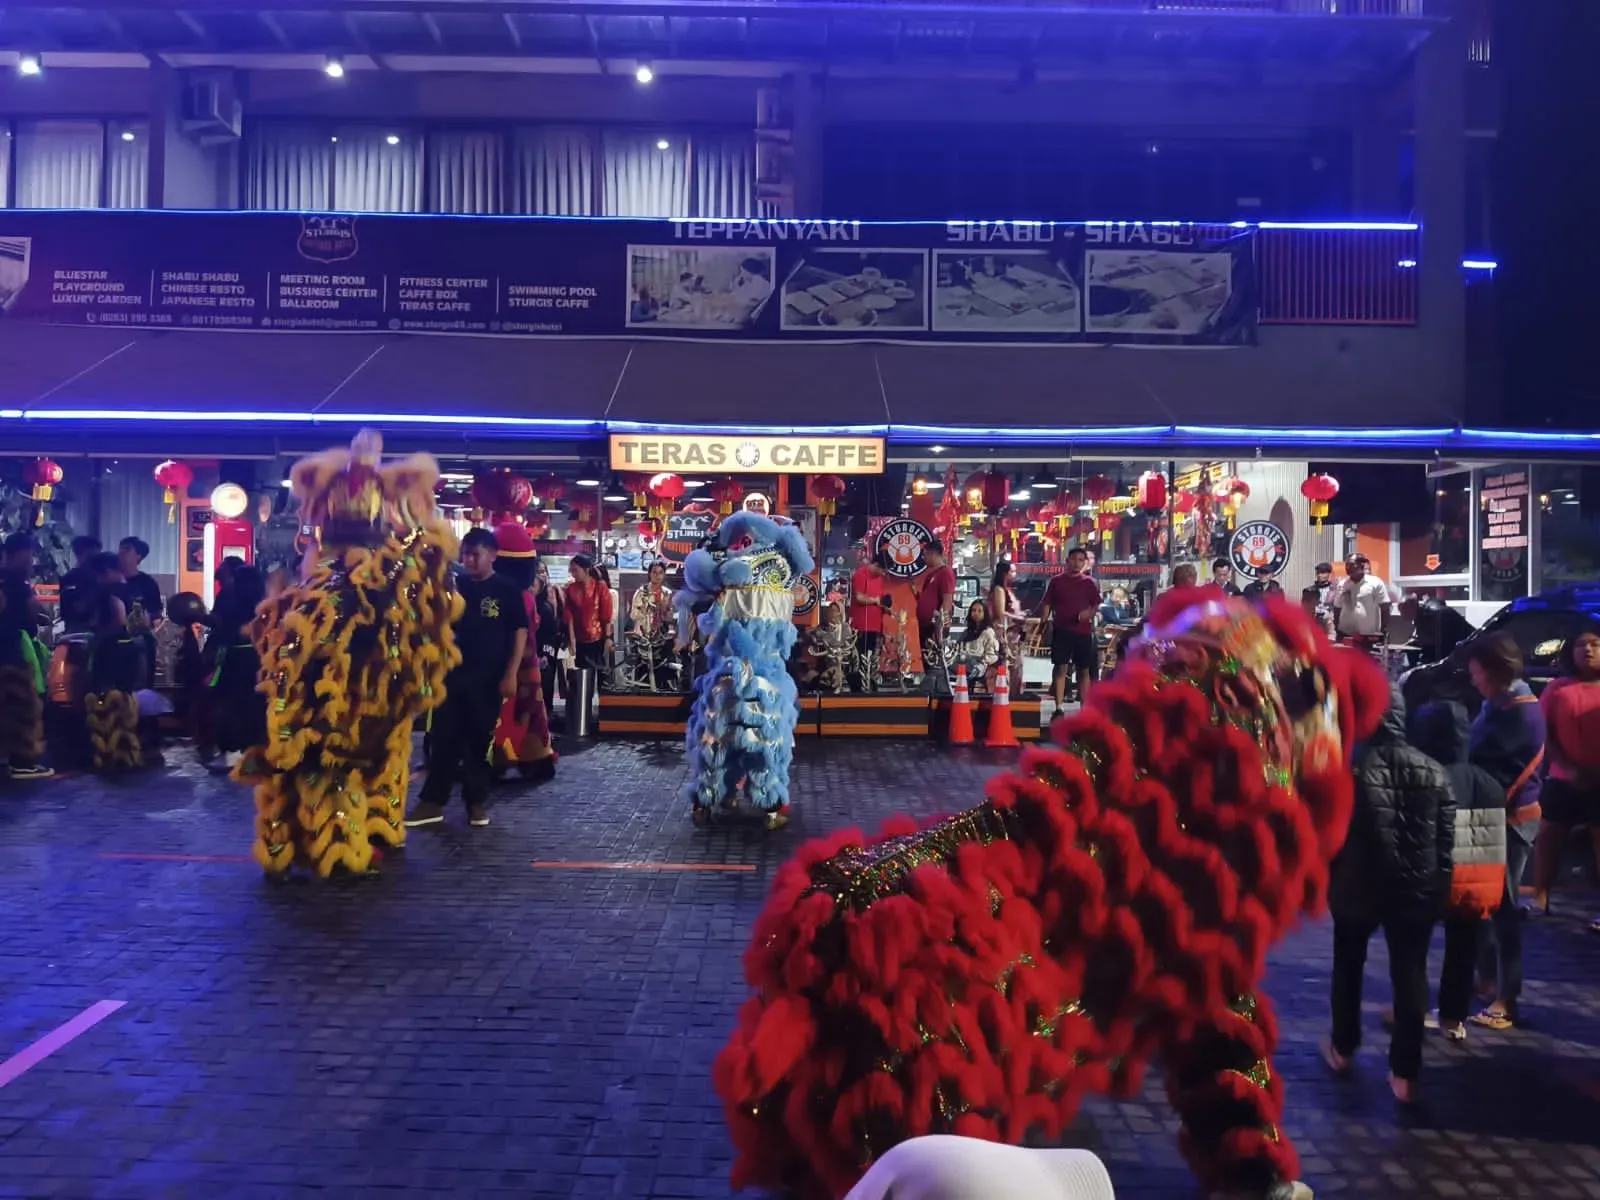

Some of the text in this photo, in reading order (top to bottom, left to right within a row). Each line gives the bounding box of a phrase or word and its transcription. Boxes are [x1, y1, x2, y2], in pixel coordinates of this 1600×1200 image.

[669, 218, 860, 241] TEPPANYAKI
[54, 270, 108, 280] BLUESTAR
[162, 271, 240, 282] SHABU SHABU
[280, 274, 366, 286] MEETING ROOM
[53, 282, 125, 292] PLAYGROUND
[399, 277, 488, 288] FITNESS CENTER
[161, 284, 245, 295] CHINESE RESTO
[280, 286, 378, 298] BUSSINES CENTER
[399, 289, 458, 299] CAFFE BOX
[508, 285, 598, 297] SWIMMING POOL
[52, 294, 142, 305] LUXURY GARDEN
[161, 296, 255, 307] JAPANESE RESTO
[280, 298, 340, 309] BALLROOM
[508, 297, 589, 309] STURGIS CAFFE
[399, 301, 471, 312] TERAS CAFFE
[618, 441, 727, 464] TERAS
[770, 444, 878, 467] CAFFE
[667, 529, 704, 539] STURGI
[883, 522, 926, 540] STURGIS
[1237, 525, 1281, 542] STURGIS
[891, 562, 920, 574] AFFE
